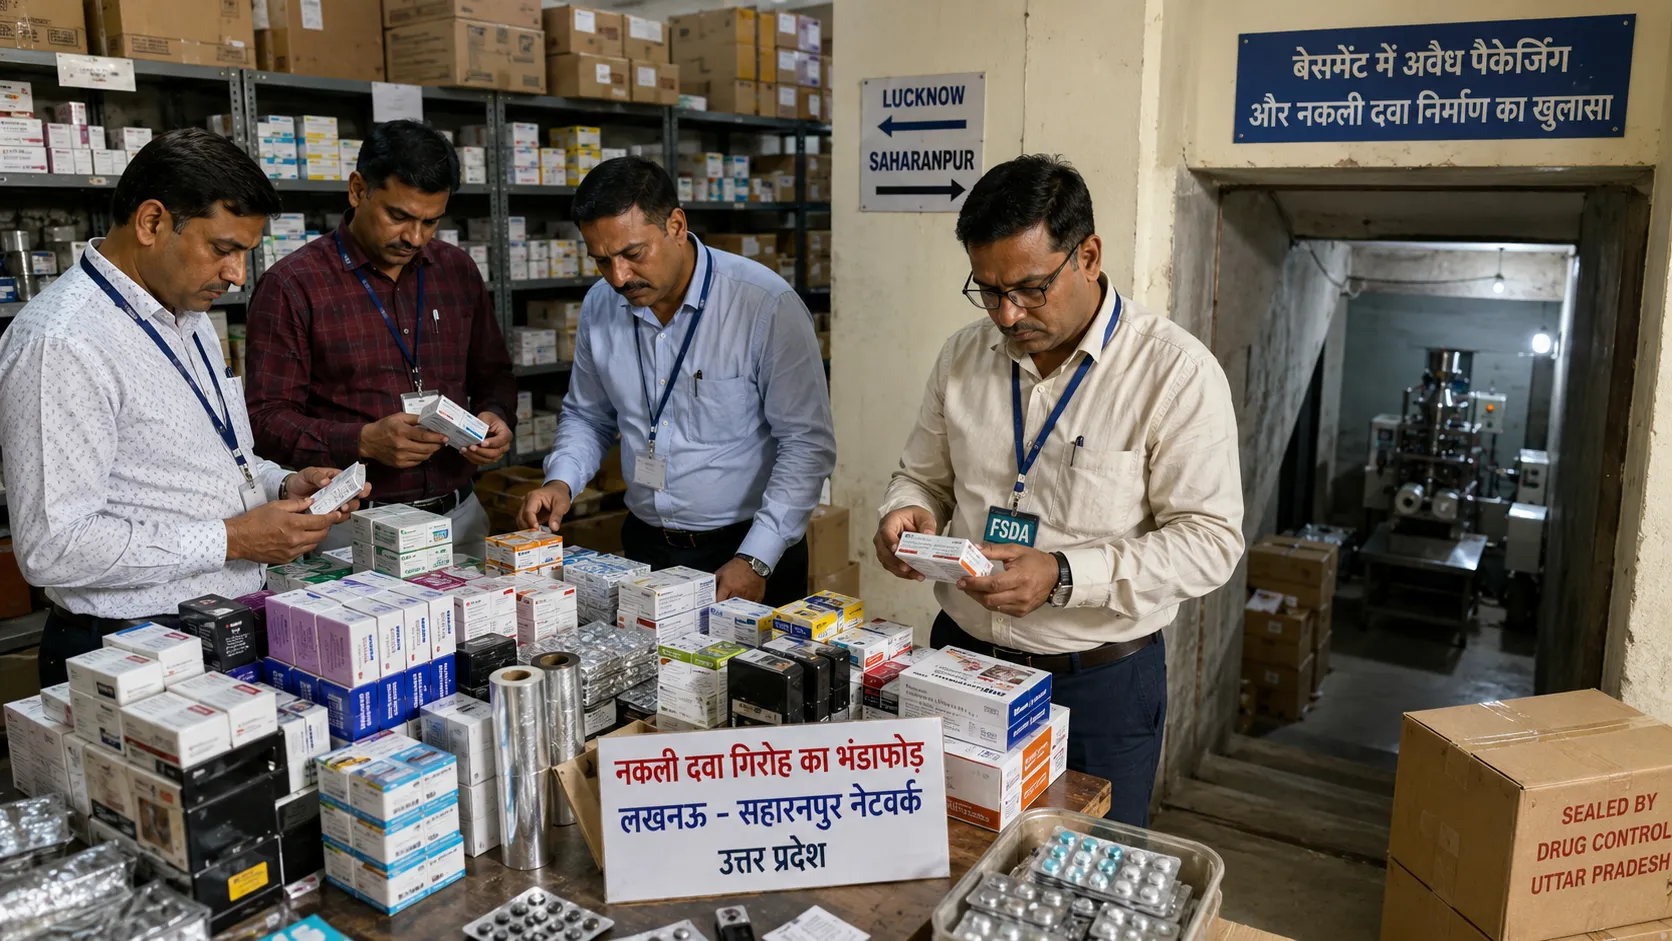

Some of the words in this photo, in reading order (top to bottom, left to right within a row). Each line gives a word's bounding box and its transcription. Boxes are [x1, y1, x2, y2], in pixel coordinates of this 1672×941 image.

[1292, 45, 1370, 80] बेसमेंट
[1375, 43, 1398, 78] में
[1403, 40, 1465, 76] अवैध
[883, 85, 966, 108] LUCKNOW
[1249, 93, 1292, 128] और
[1297, 91, 1365, 127] नकली
[1370, 100, 1411, 128] दवा
[1416, 88, 1490, 124] निर्माण
[1496, 97, 1528, 122] का
[1532, 95, 1614, 132] खुलासा
[869, 150, 975, 171] SAHARANPUR
[989, 517, 1030, 544] FSDA
[614, 748, 679, 785] नकली
[685, 753, 725, 783] दवा
[730, 741, 792, 778] गिरोह
[799, 747, 829, 774] का
[836, 734, 925, 774] भंडाफोड़
[618, 802, 707, 834] लखनऊ
[737, 793, 843, 831] सहारनपुर
[849, 779, 923, 818] नेटवर्क
[1561, 797, 1629, 825] SEALED
[1634, 792, 1658, 813] BY
[718, 846, 766, 876] उत्तर
[772, 835, 827, 873] प्रदेश
[1537, 836, 1587, 862] DRUG
[1592, 821, 1672, 852] CONTROL
[1531, 868, 1587, 895] UTTAR
[1591, 852, 1671, 884] PRADESH
